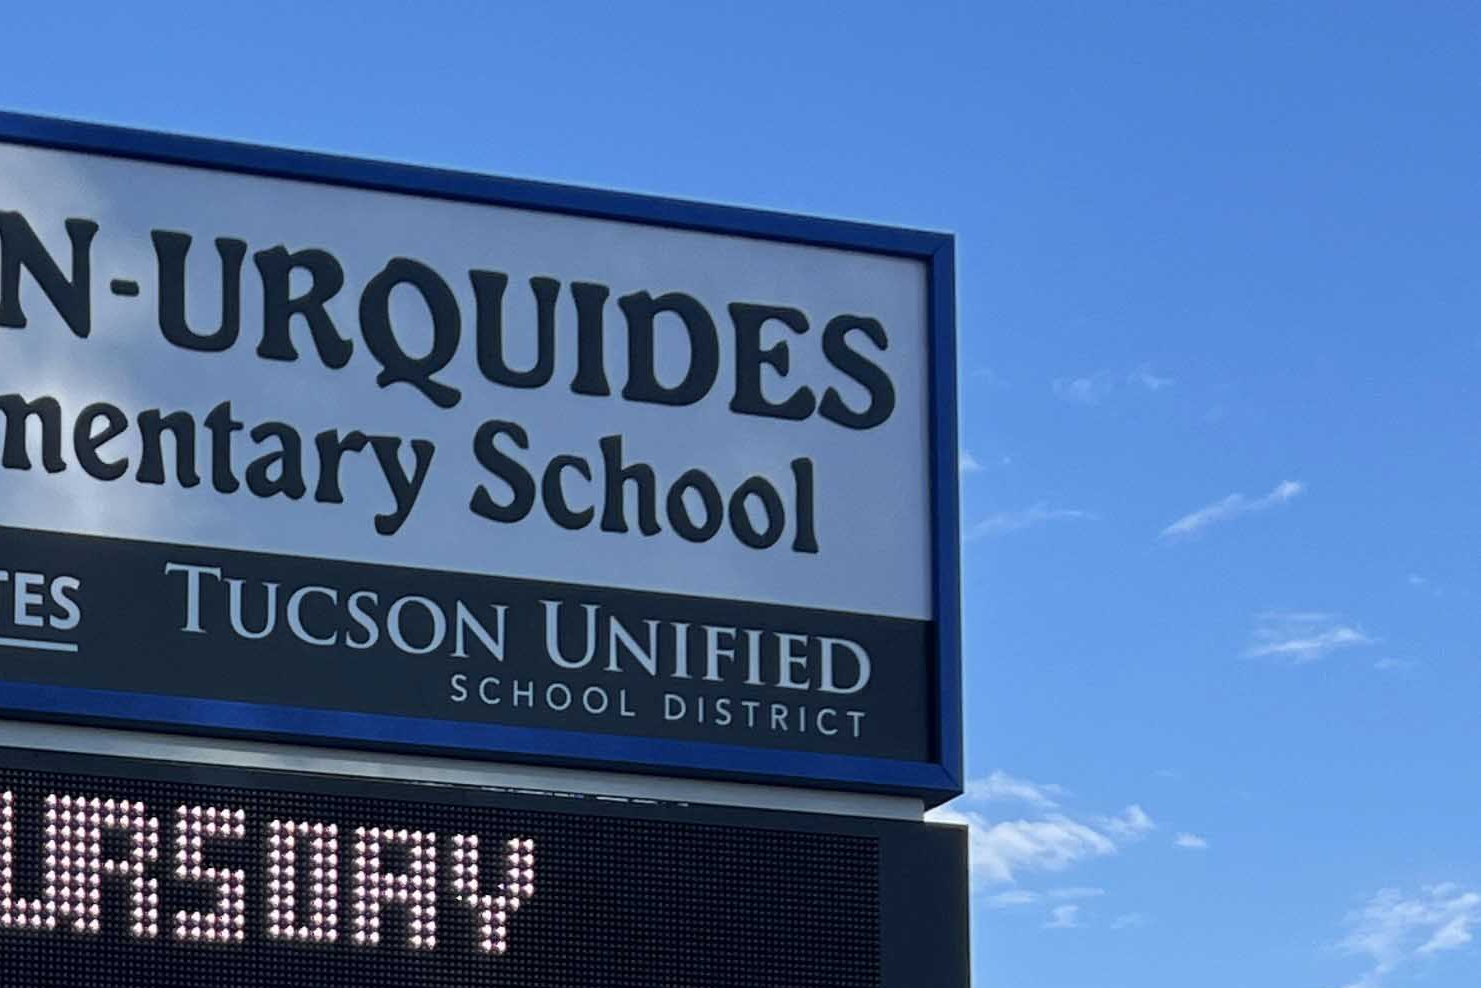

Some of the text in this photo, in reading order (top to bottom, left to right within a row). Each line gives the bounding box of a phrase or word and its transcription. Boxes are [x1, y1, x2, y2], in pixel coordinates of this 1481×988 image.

[469, 419, 819, 555] School
[450, 674, 866, 738] SCHOOL DISTRICT
